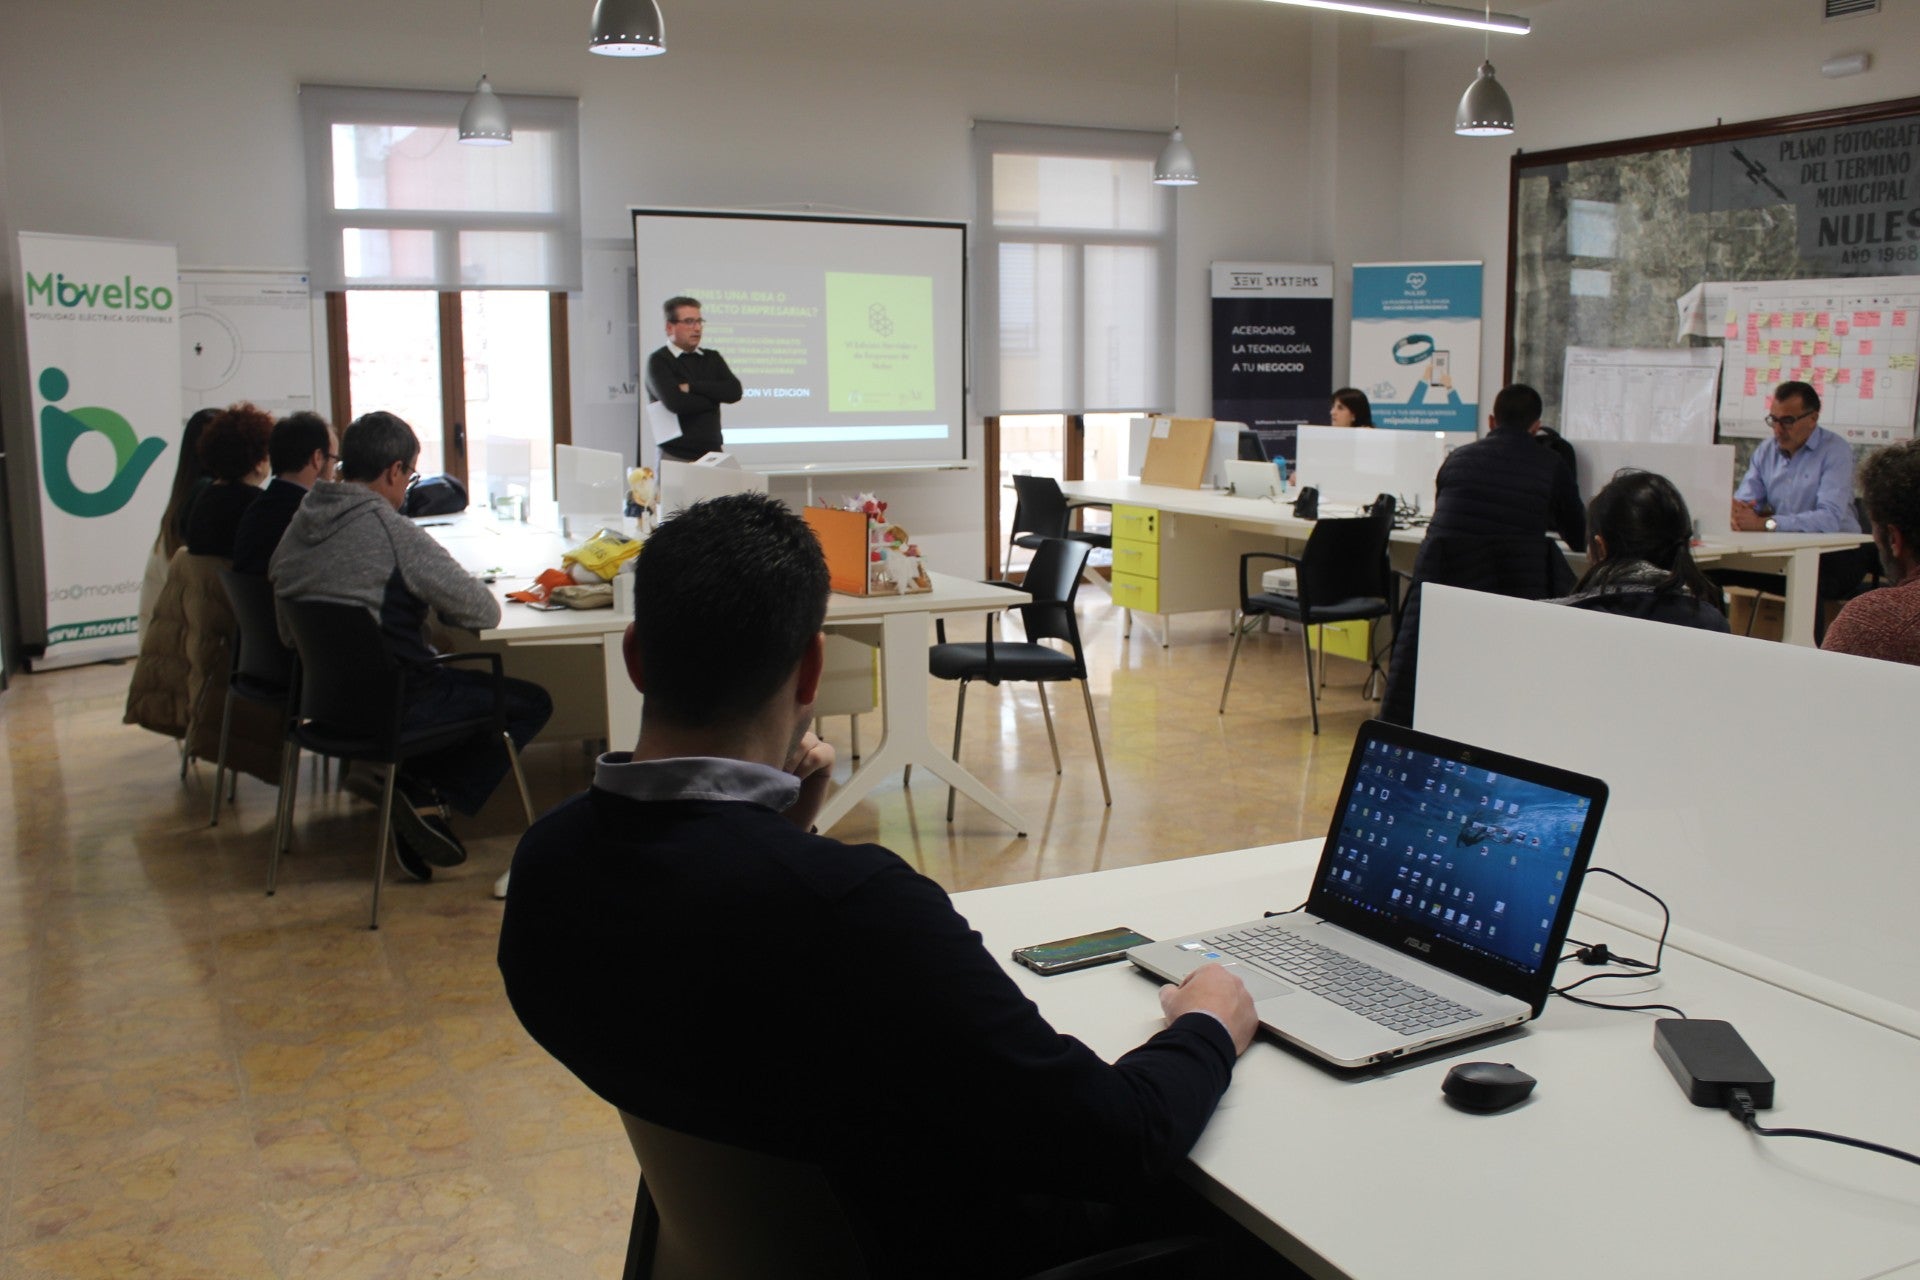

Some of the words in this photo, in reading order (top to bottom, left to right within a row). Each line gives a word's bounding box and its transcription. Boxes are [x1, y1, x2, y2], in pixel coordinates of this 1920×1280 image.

[1779, 136, 1826, 161] PLANO
[1801, 162, 1828, 184] DEL
[1835, 151, 1911, 181] TERMINO
[1816, 179, 1908, 207] MUNICIPAL
[1818, 208, 1920, 247] NULES
[1877, 245, 1918, 263] 1968
[724, 290, 749, 302] UNA
[1232, 325, 1296, 335] ACERCAMOS
[1232, 344, 1246, 353] LA
[1232, 362, 1241, 372] A
[1242, 362, 1255, 372] TU
[1257, 362, 1304, 372] NEGOCIO
[742, 388, 761, 398] ION
[774, 388, 811, 398] EDICION
[1403, 936, 1432, 953] ASUS
